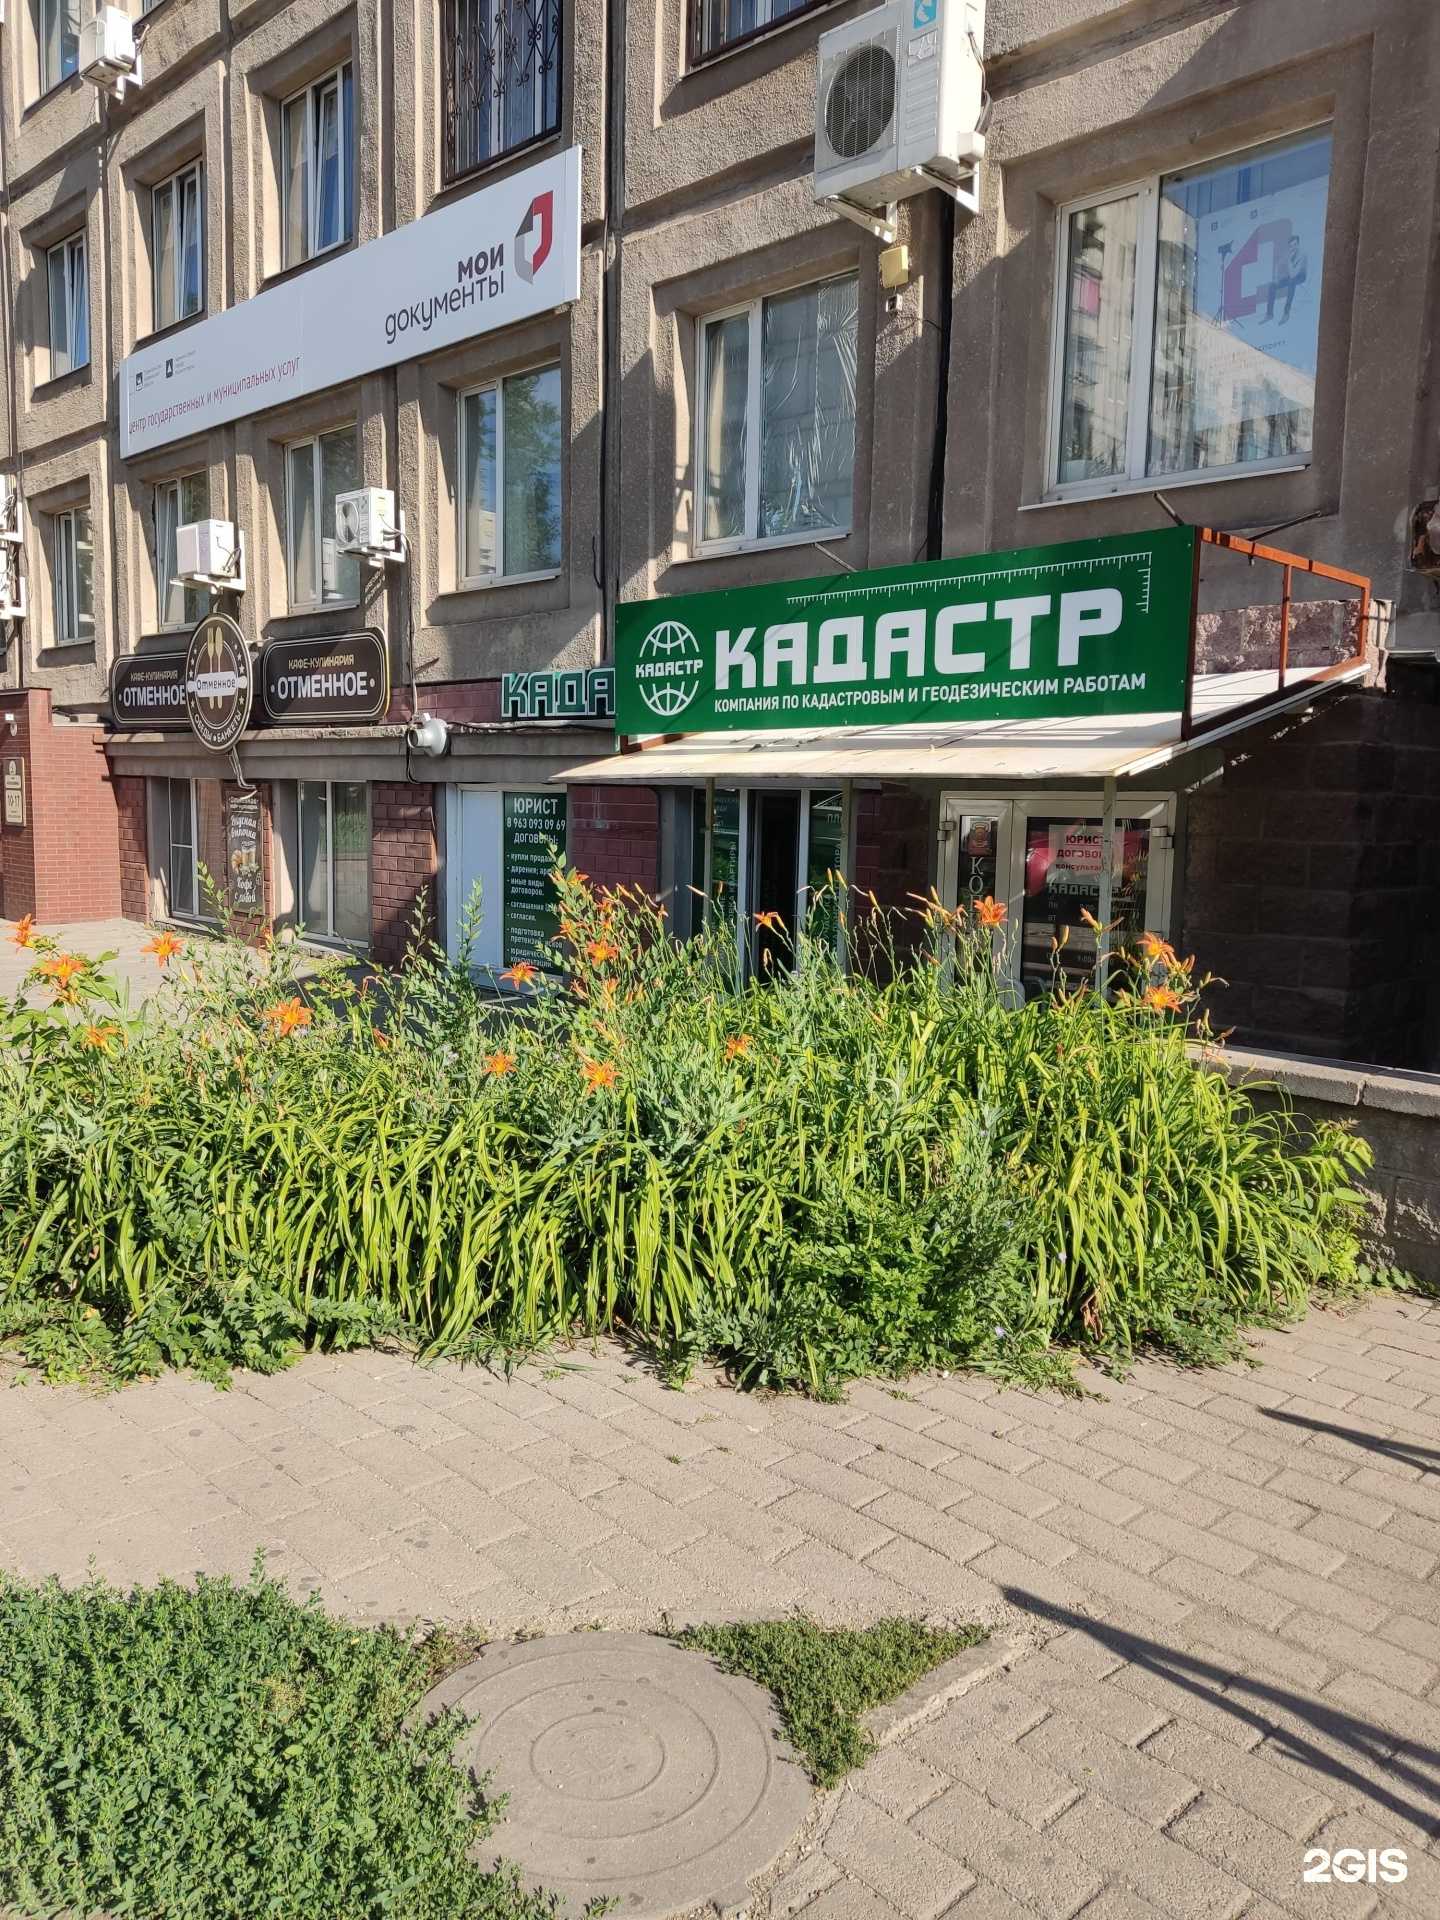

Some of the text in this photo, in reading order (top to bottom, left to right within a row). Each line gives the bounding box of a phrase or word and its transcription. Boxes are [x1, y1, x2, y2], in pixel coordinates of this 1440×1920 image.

[458, 243, 504, 283] мои
[385, 270, 504, 344] документы
[147, 396, 205, 429] государственных
[207, 392, 212, 404] и
[213, 366, 276, 405] муниципальных
[278, 357, 301, 382] услуг
[714, 587, 1123, 691] КАДАСТР
[288, 654, 354, 670] КАФЕ-КУЛИНАРИЯ
[635, 659, 704, 679] КАДАСТР
[123, 684, 187, 707] ОТМЕННОЕ
[277, 671, 368, 699] ОТМЕННОЕ
[714, 673, 1146, 713] КОМПАНИЯ ПО КАДАСТРОВЫМ И ГЕОДЕЗИЧЕСКИМ РАБОТАМ
[514, 797, 558, 815] ЮРИСТ
[513, 817, 527, 829] 963
[528, 818, 543, 830] 093
[544, 819, 554, 830] 09
[556, 819, 566, 831] 69
